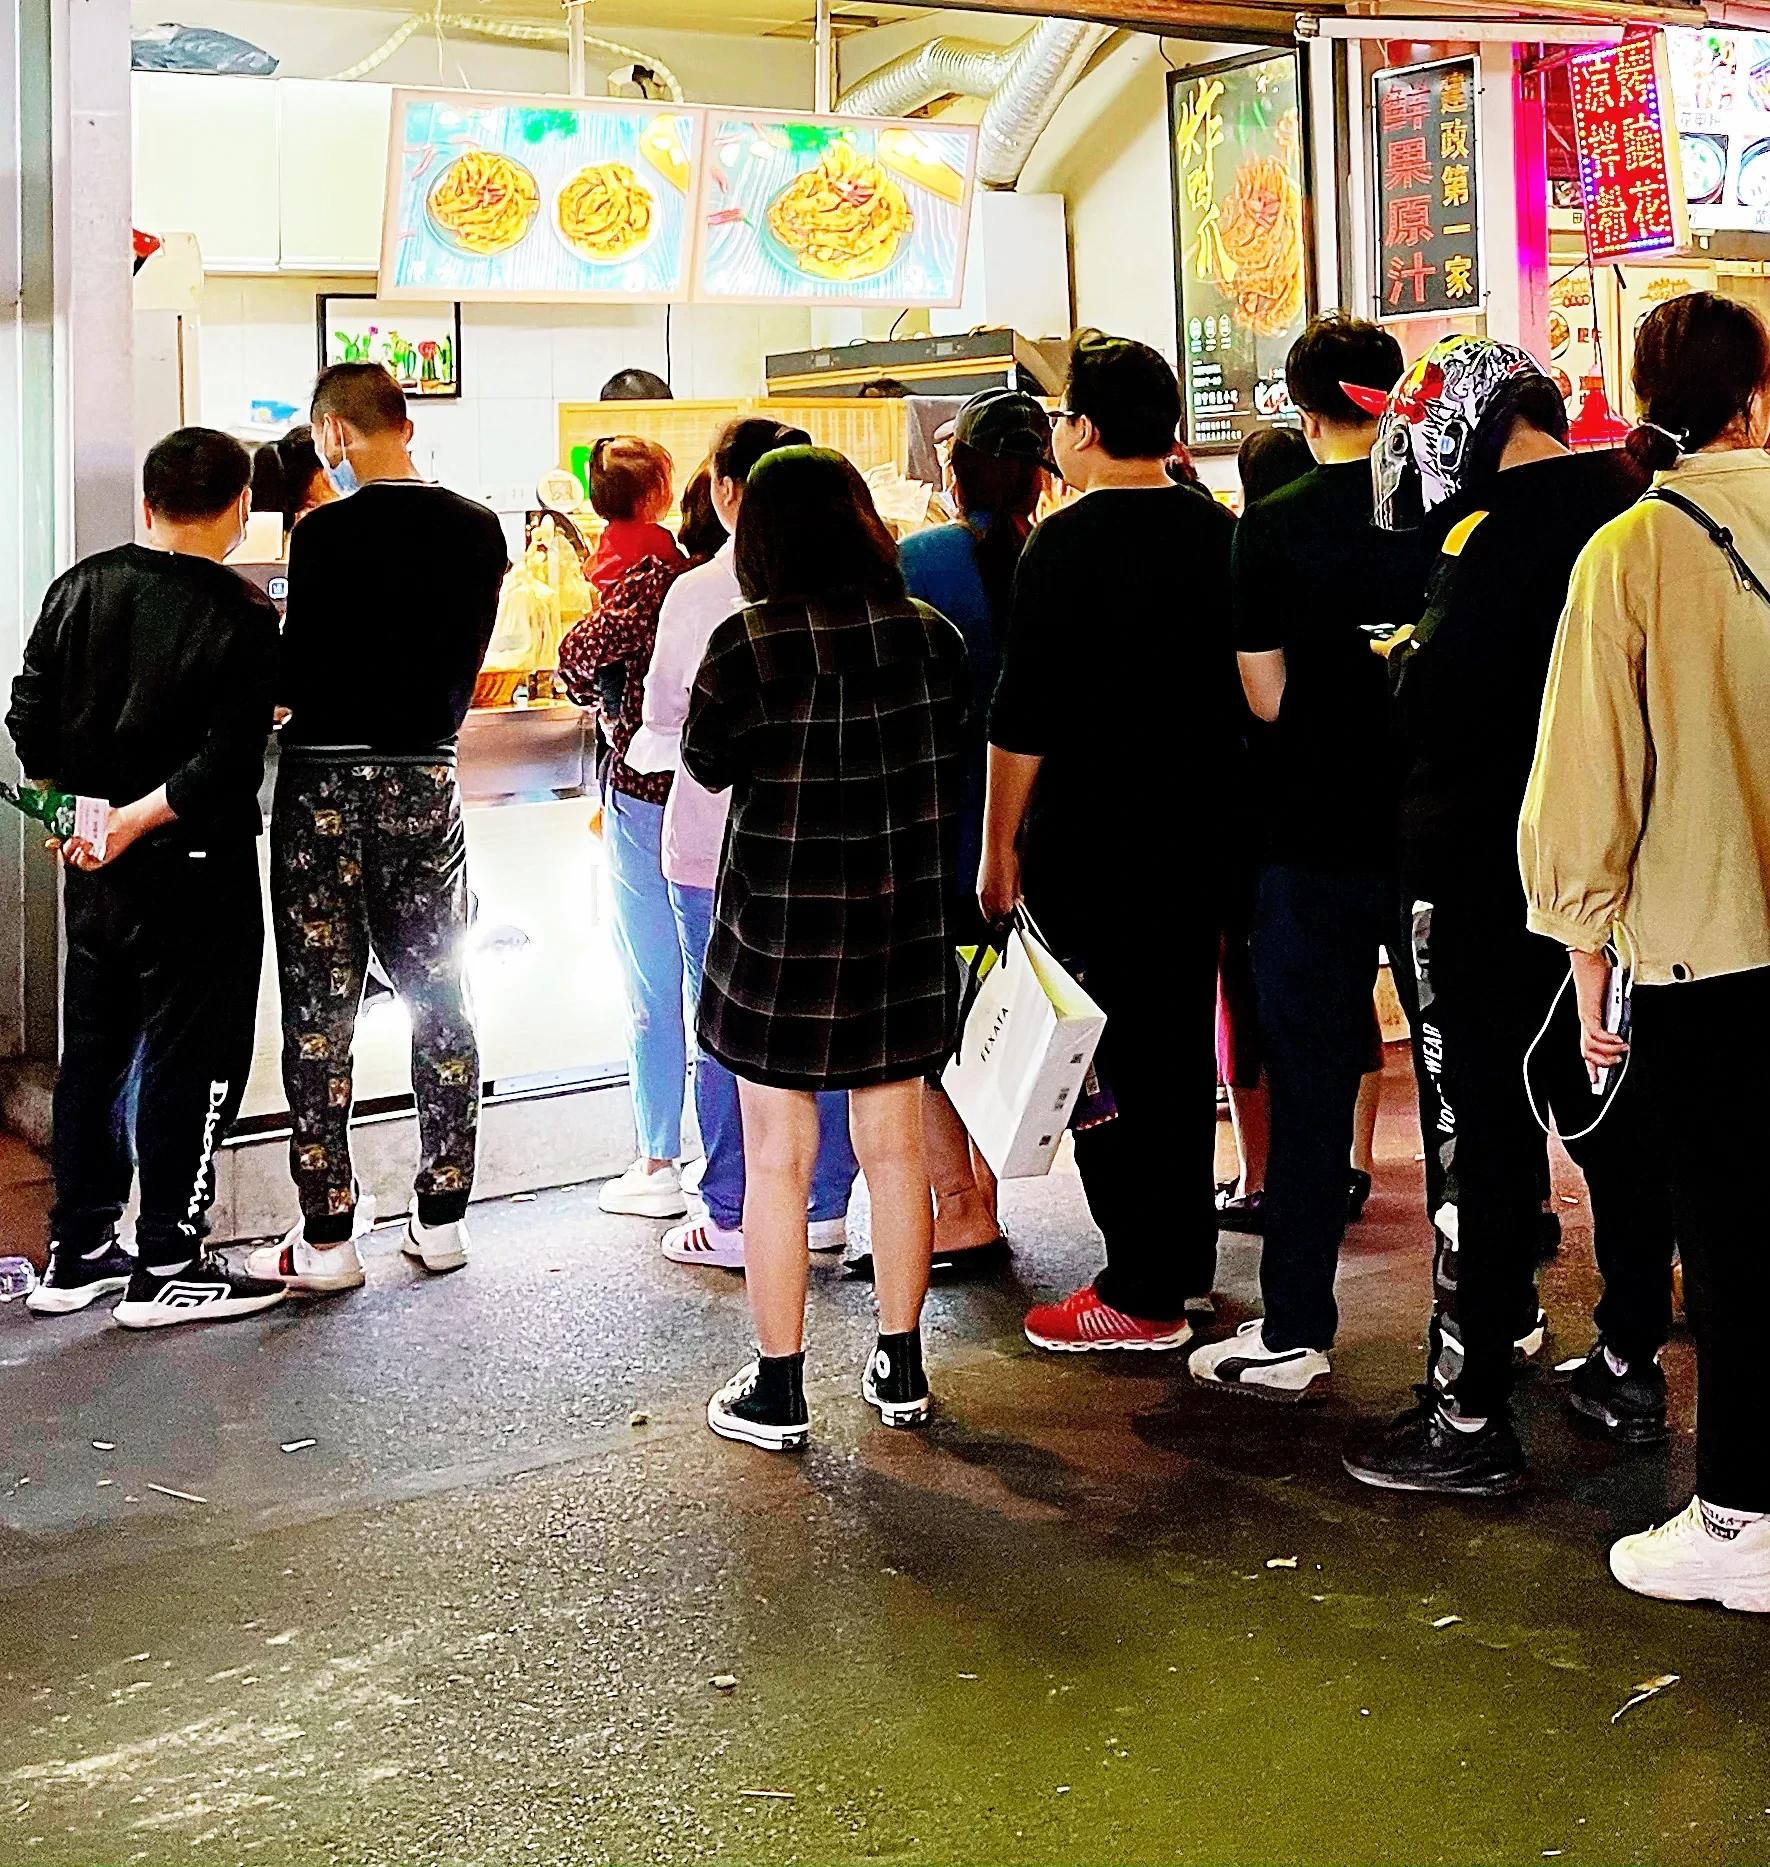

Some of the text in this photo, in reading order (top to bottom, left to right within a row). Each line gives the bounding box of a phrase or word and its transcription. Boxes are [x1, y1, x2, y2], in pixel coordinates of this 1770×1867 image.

[1382, 80, 1438, 305] 鲜果原汁
[1440, 71, 1474, 299] 建政第一家
